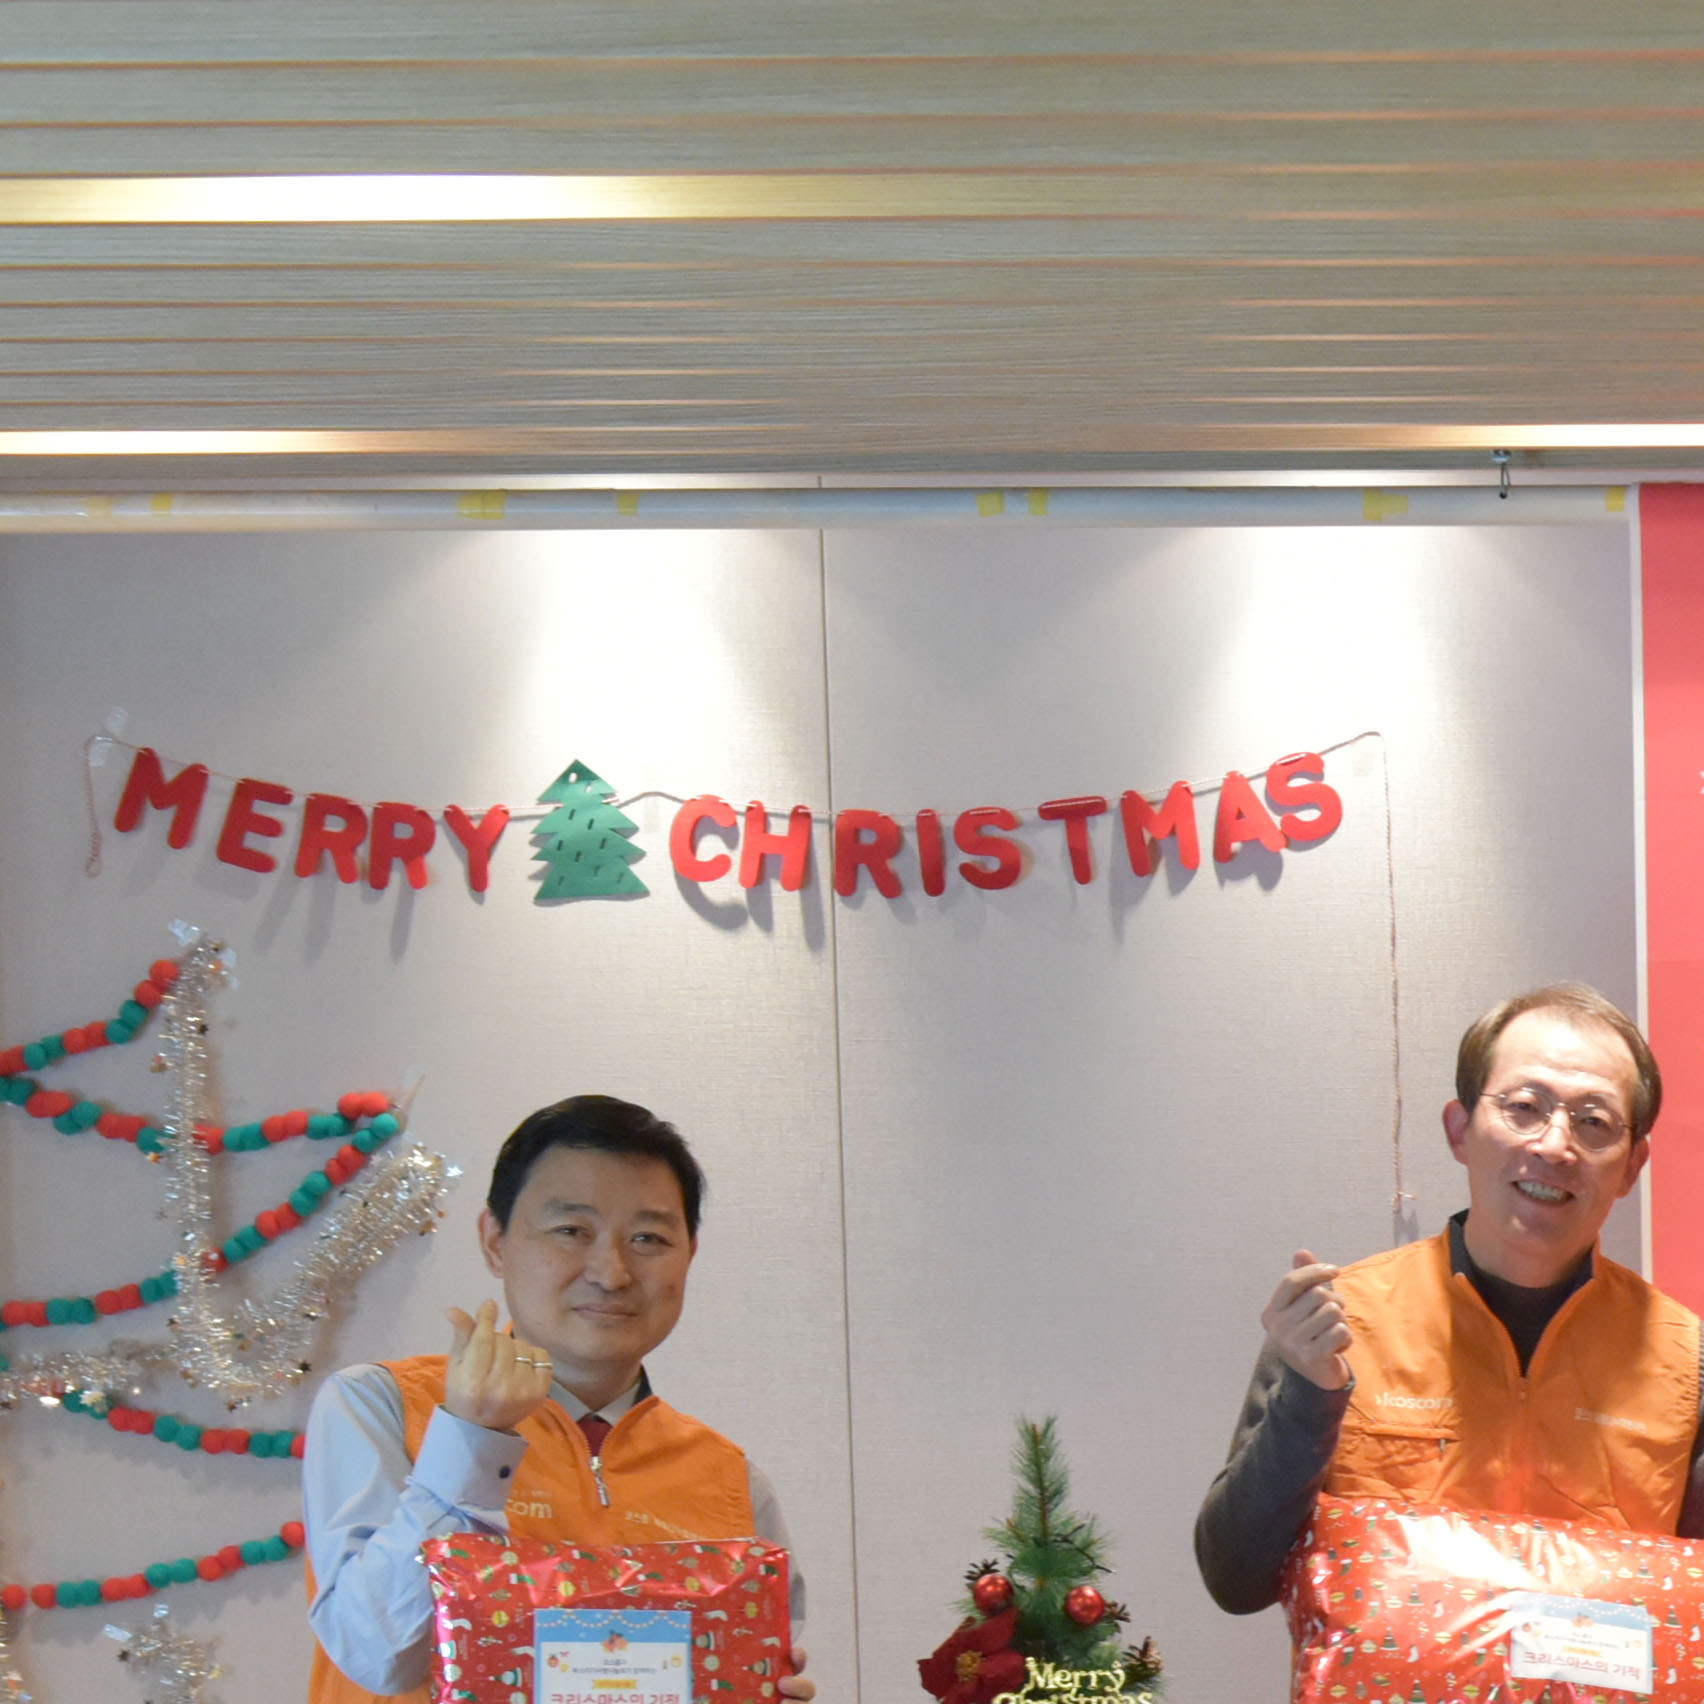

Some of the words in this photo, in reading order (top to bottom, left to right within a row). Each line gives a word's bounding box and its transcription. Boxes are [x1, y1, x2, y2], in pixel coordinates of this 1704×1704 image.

[113, 745, 512, 894] MERRY
[669, 749, 1344, 900] CHRISTMAS
[1025, 1657, 1125, 1692] Merry
